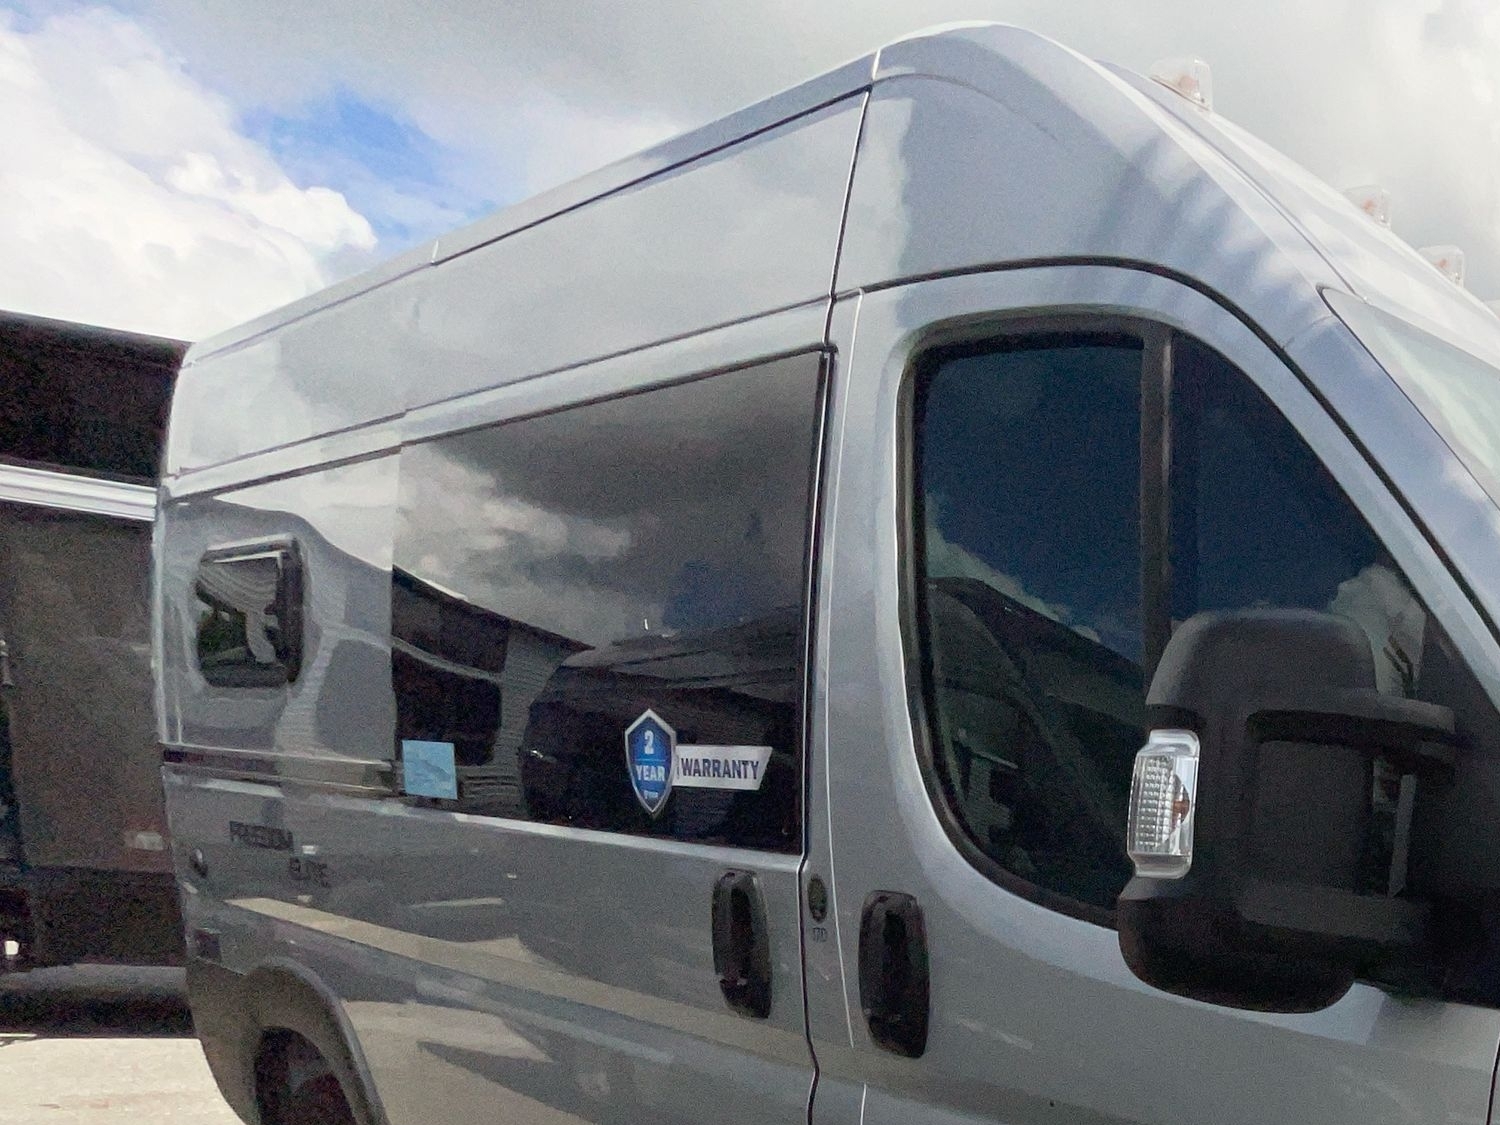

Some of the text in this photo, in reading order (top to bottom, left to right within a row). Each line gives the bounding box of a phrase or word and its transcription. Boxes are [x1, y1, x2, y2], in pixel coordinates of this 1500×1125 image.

[643, 729, 655, 755] 2
[635, 764, 666, 782] YEAR
[680, 757, 760, 780] WARRANTY
